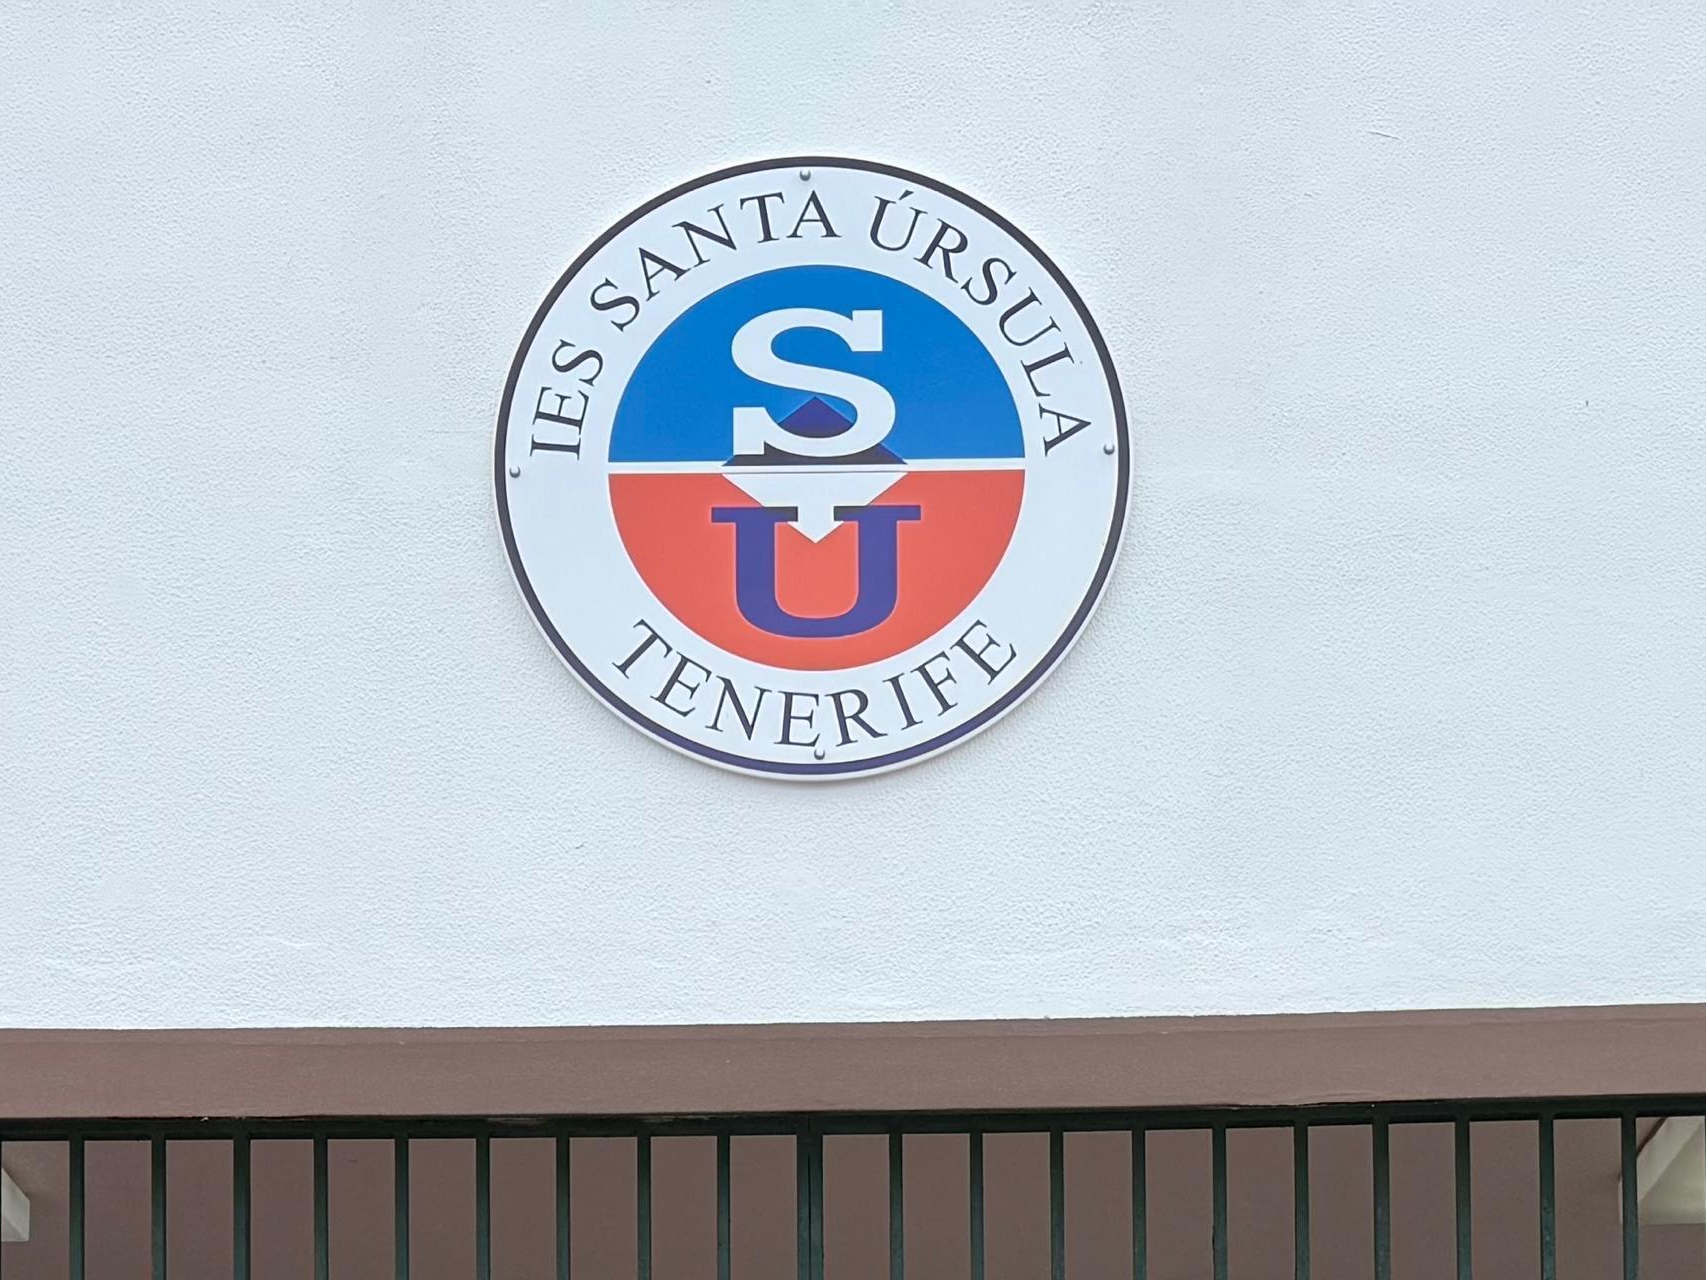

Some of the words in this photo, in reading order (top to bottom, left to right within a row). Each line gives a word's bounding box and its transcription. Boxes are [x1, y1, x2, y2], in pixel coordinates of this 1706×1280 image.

[529, 339, 604, 461] IES
[589, 190, 842, 333] SANTA
[867, 189, 1092, 457] ÚRSULA
[730, 307, 896, 458] S
[711, 504, 921, 639] U
[611, 617, 1017, 748] TENERIFE
